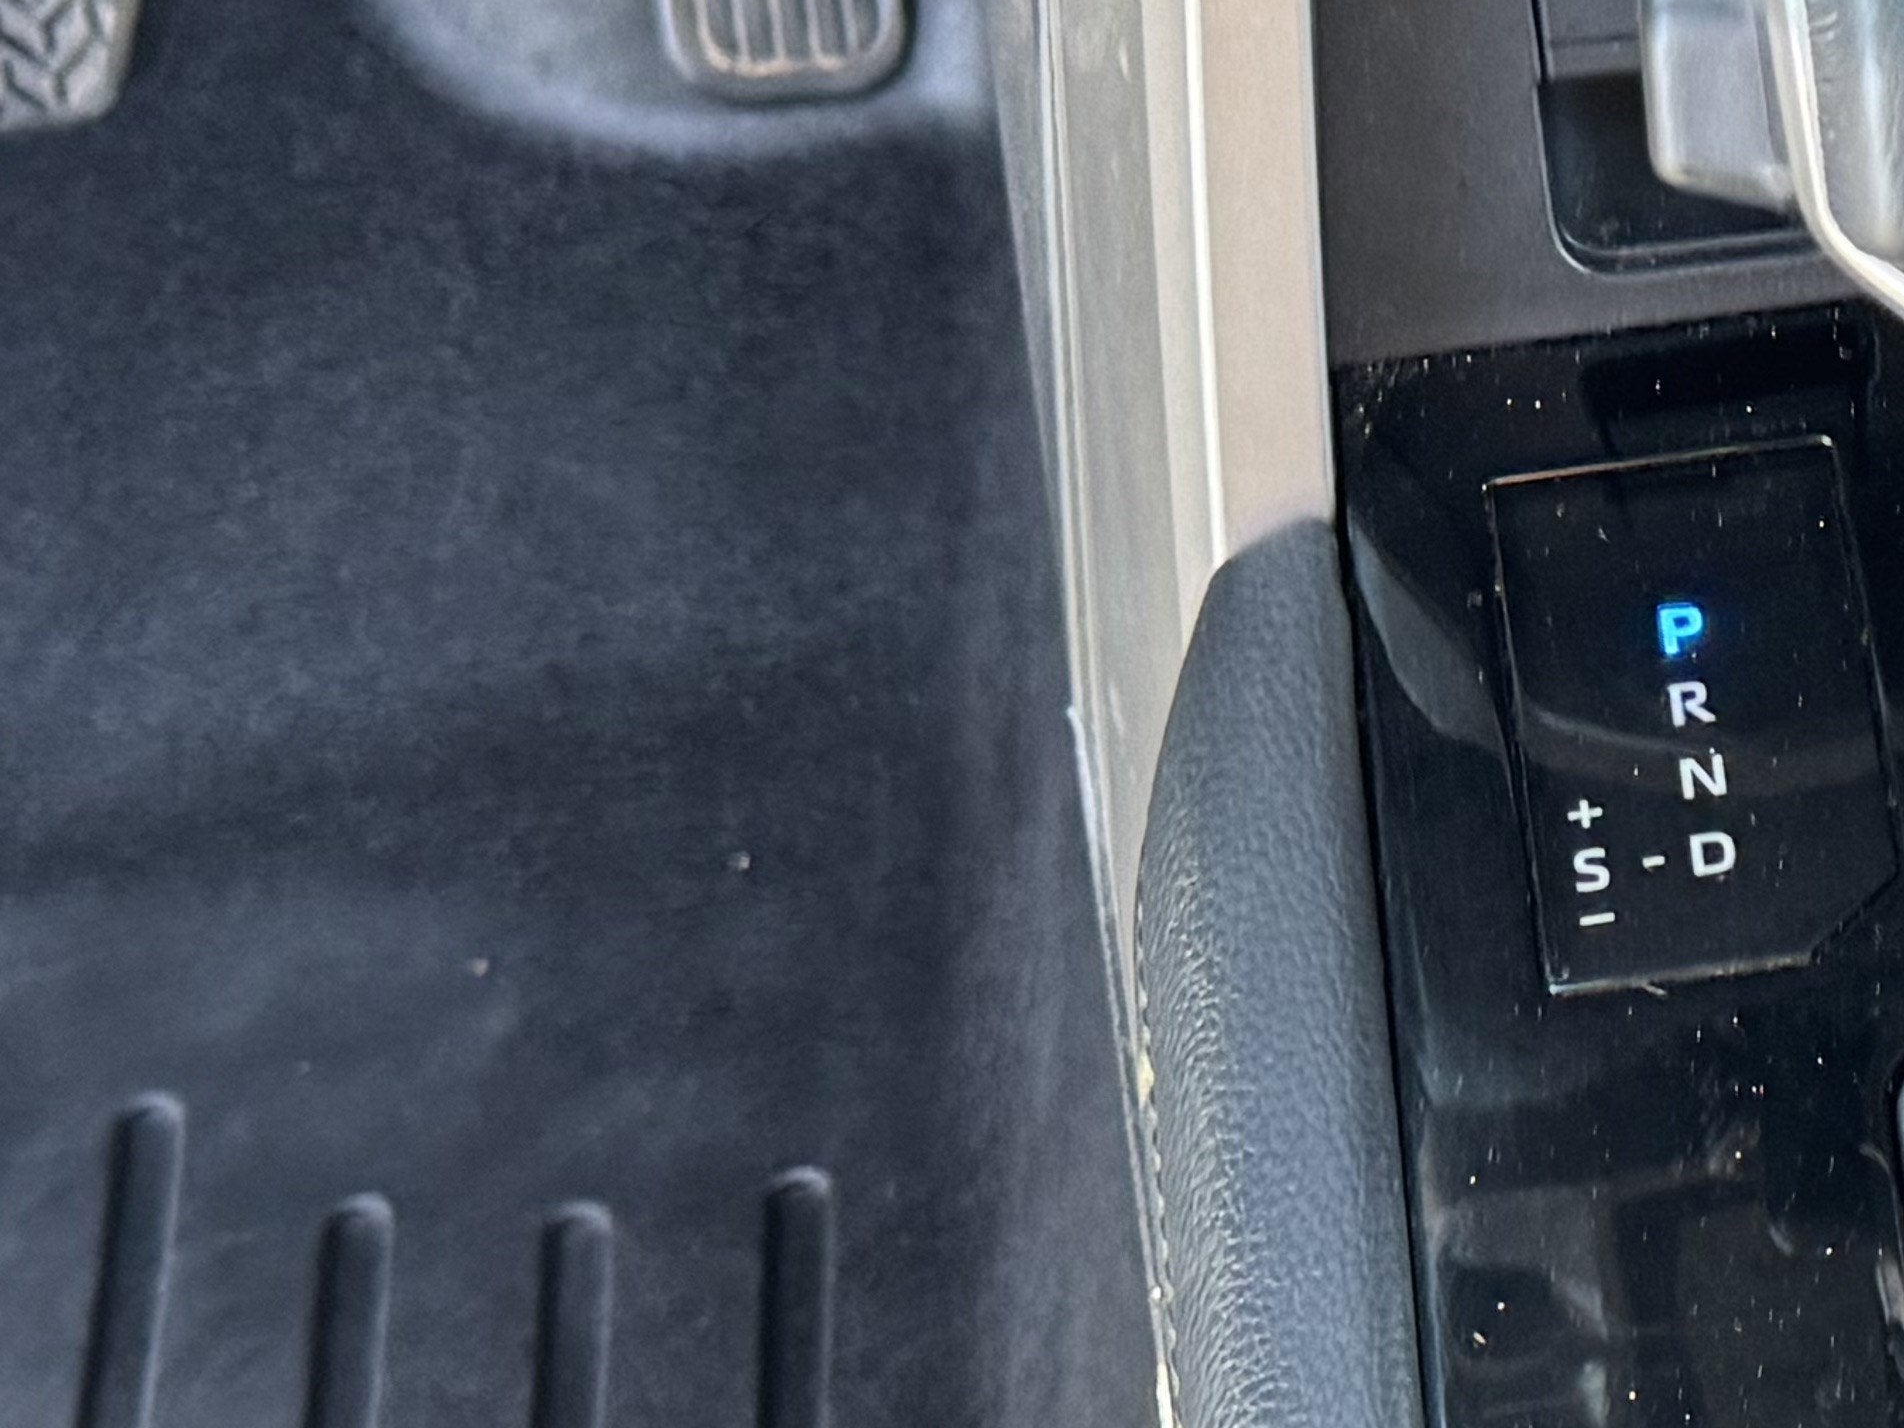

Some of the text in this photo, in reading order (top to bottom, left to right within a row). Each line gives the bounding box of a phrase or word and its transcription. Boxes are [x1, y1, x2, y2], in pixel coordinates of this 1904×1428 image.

[1656, 601, 1704, 656] P
[1666, 680, 1717, 728] R
[1678, 752, 1728, 801] N
[1572, 846, 1612, 893] S
[1688, 830, 1737, 878] D
